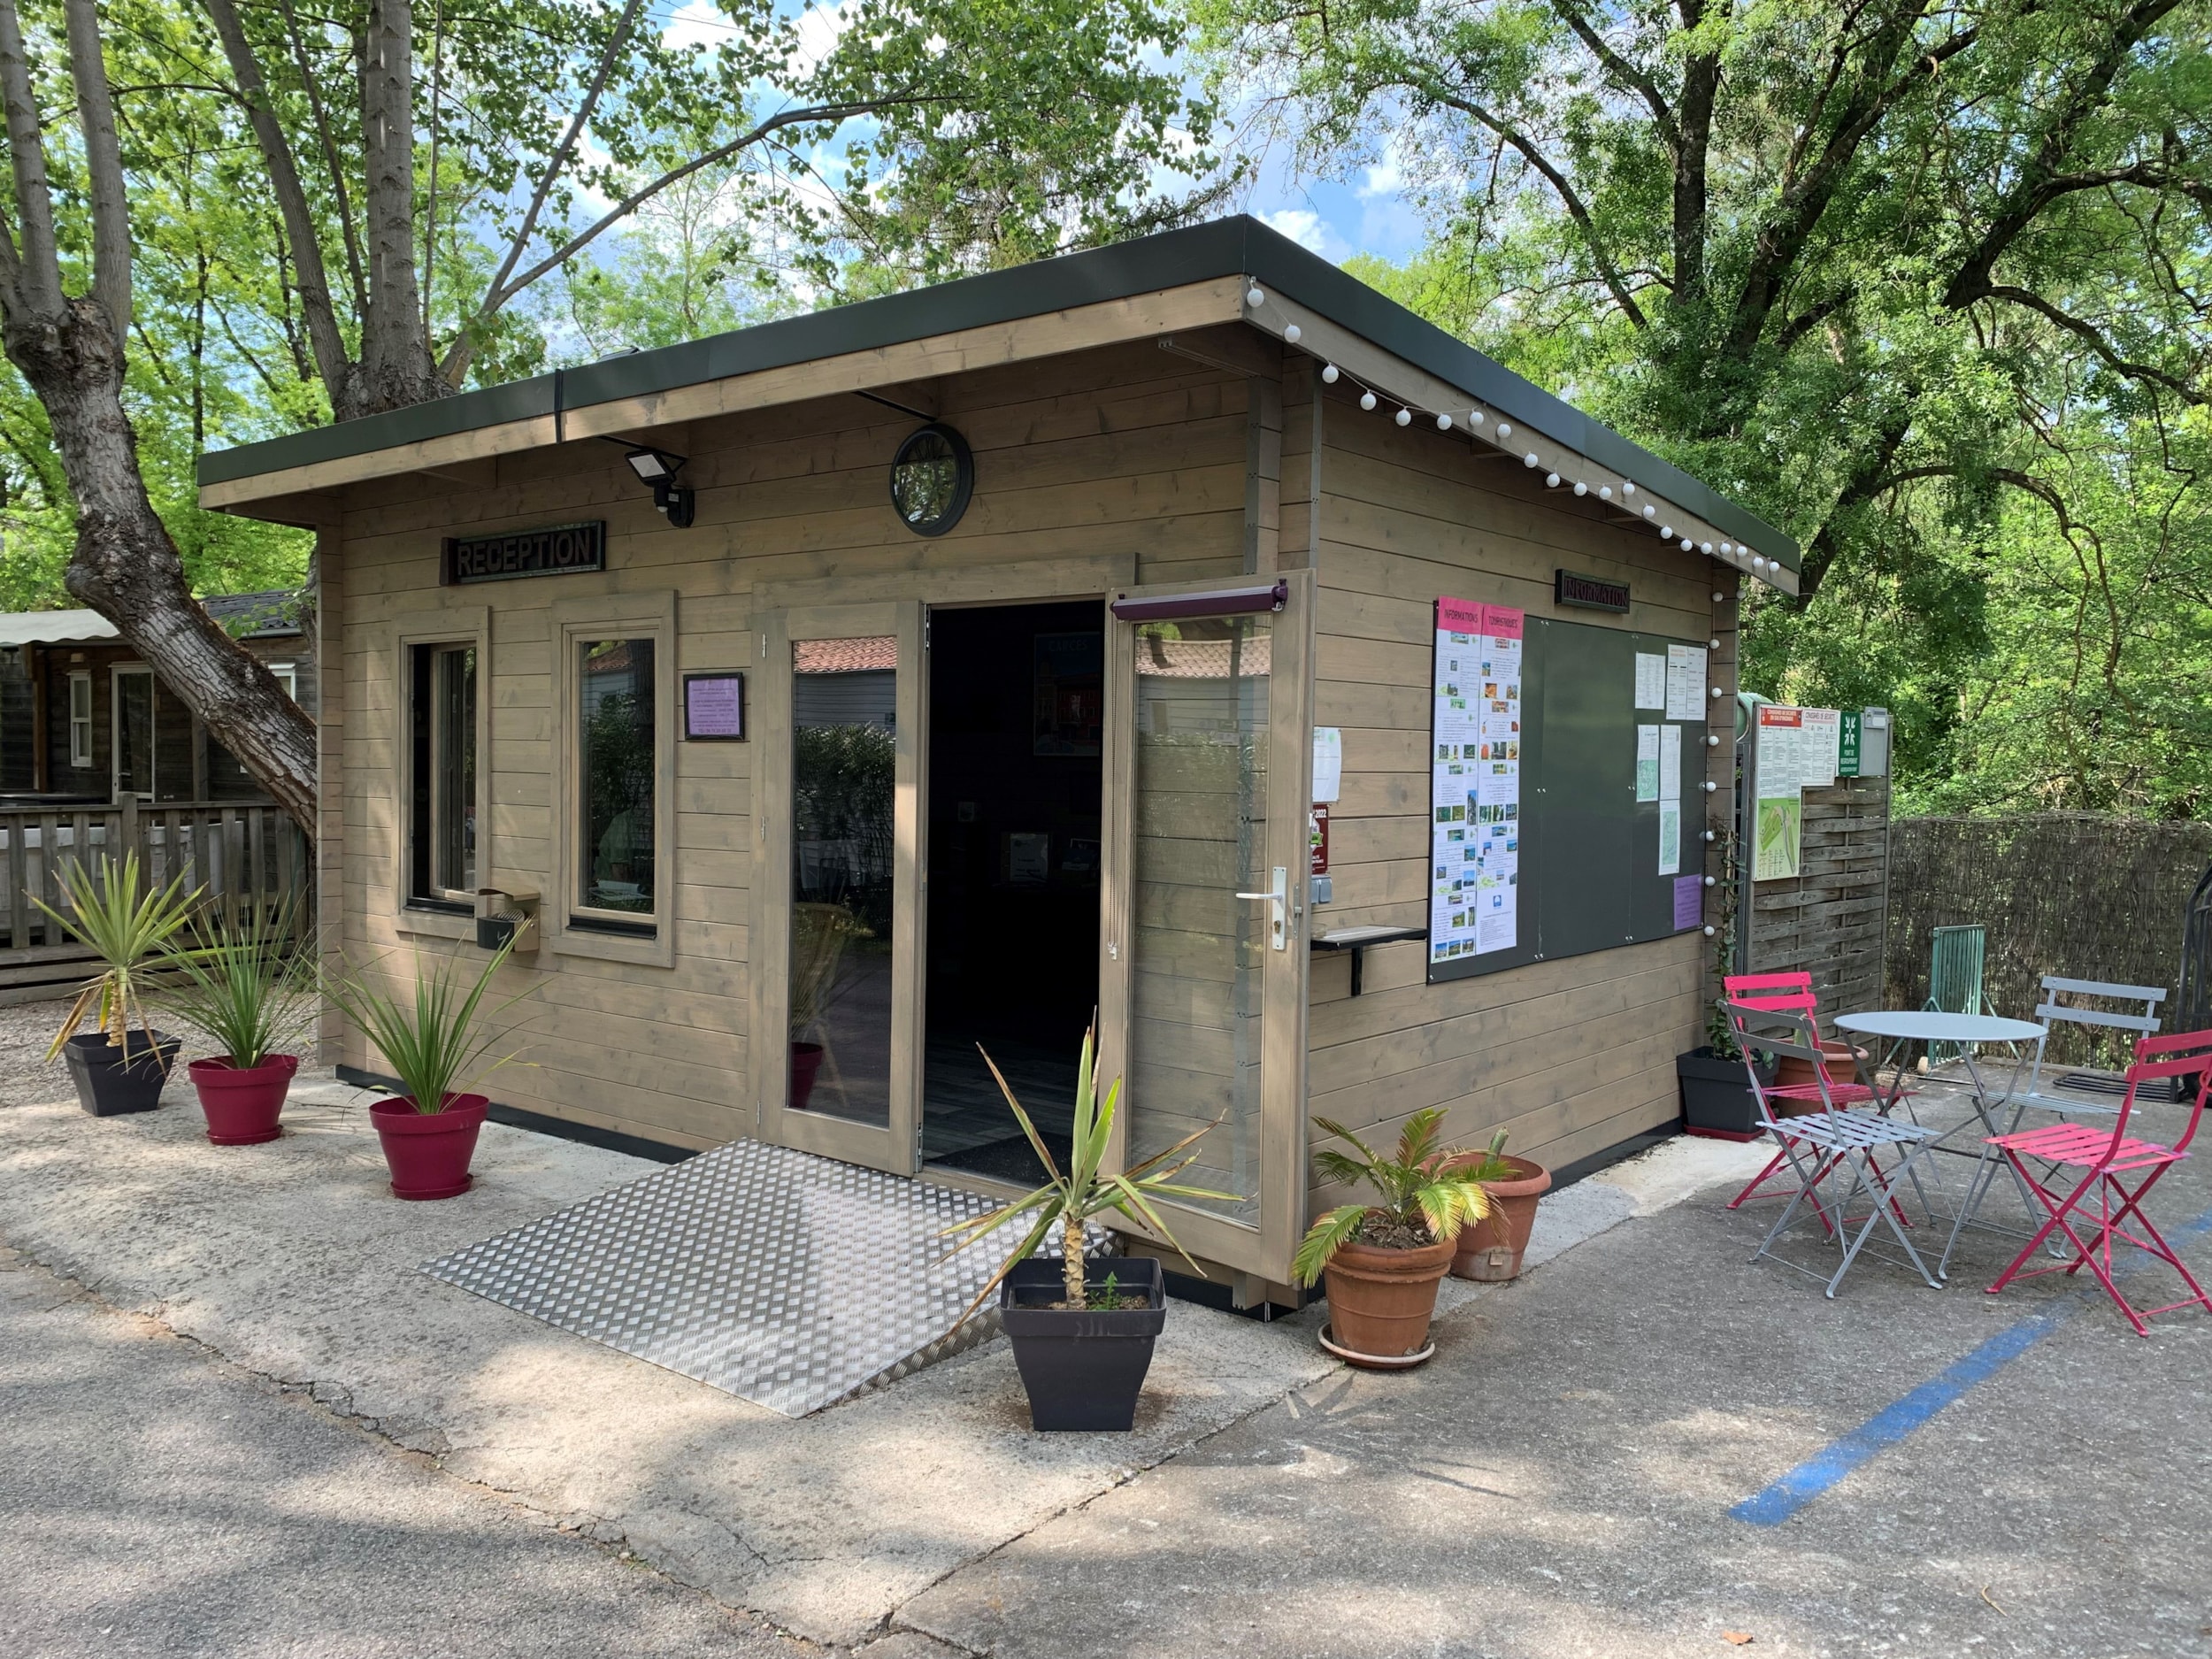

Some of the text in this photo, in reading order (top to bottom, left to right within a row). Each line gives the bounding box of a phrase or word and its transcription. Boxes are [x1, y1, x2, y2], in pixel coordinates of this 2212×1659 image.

[457, 529, 590, 576] RECEPTION
[1564, 578, 1628, 606] INFORMATION
[1444, 609, 1478, 623] INFORMATIONS
